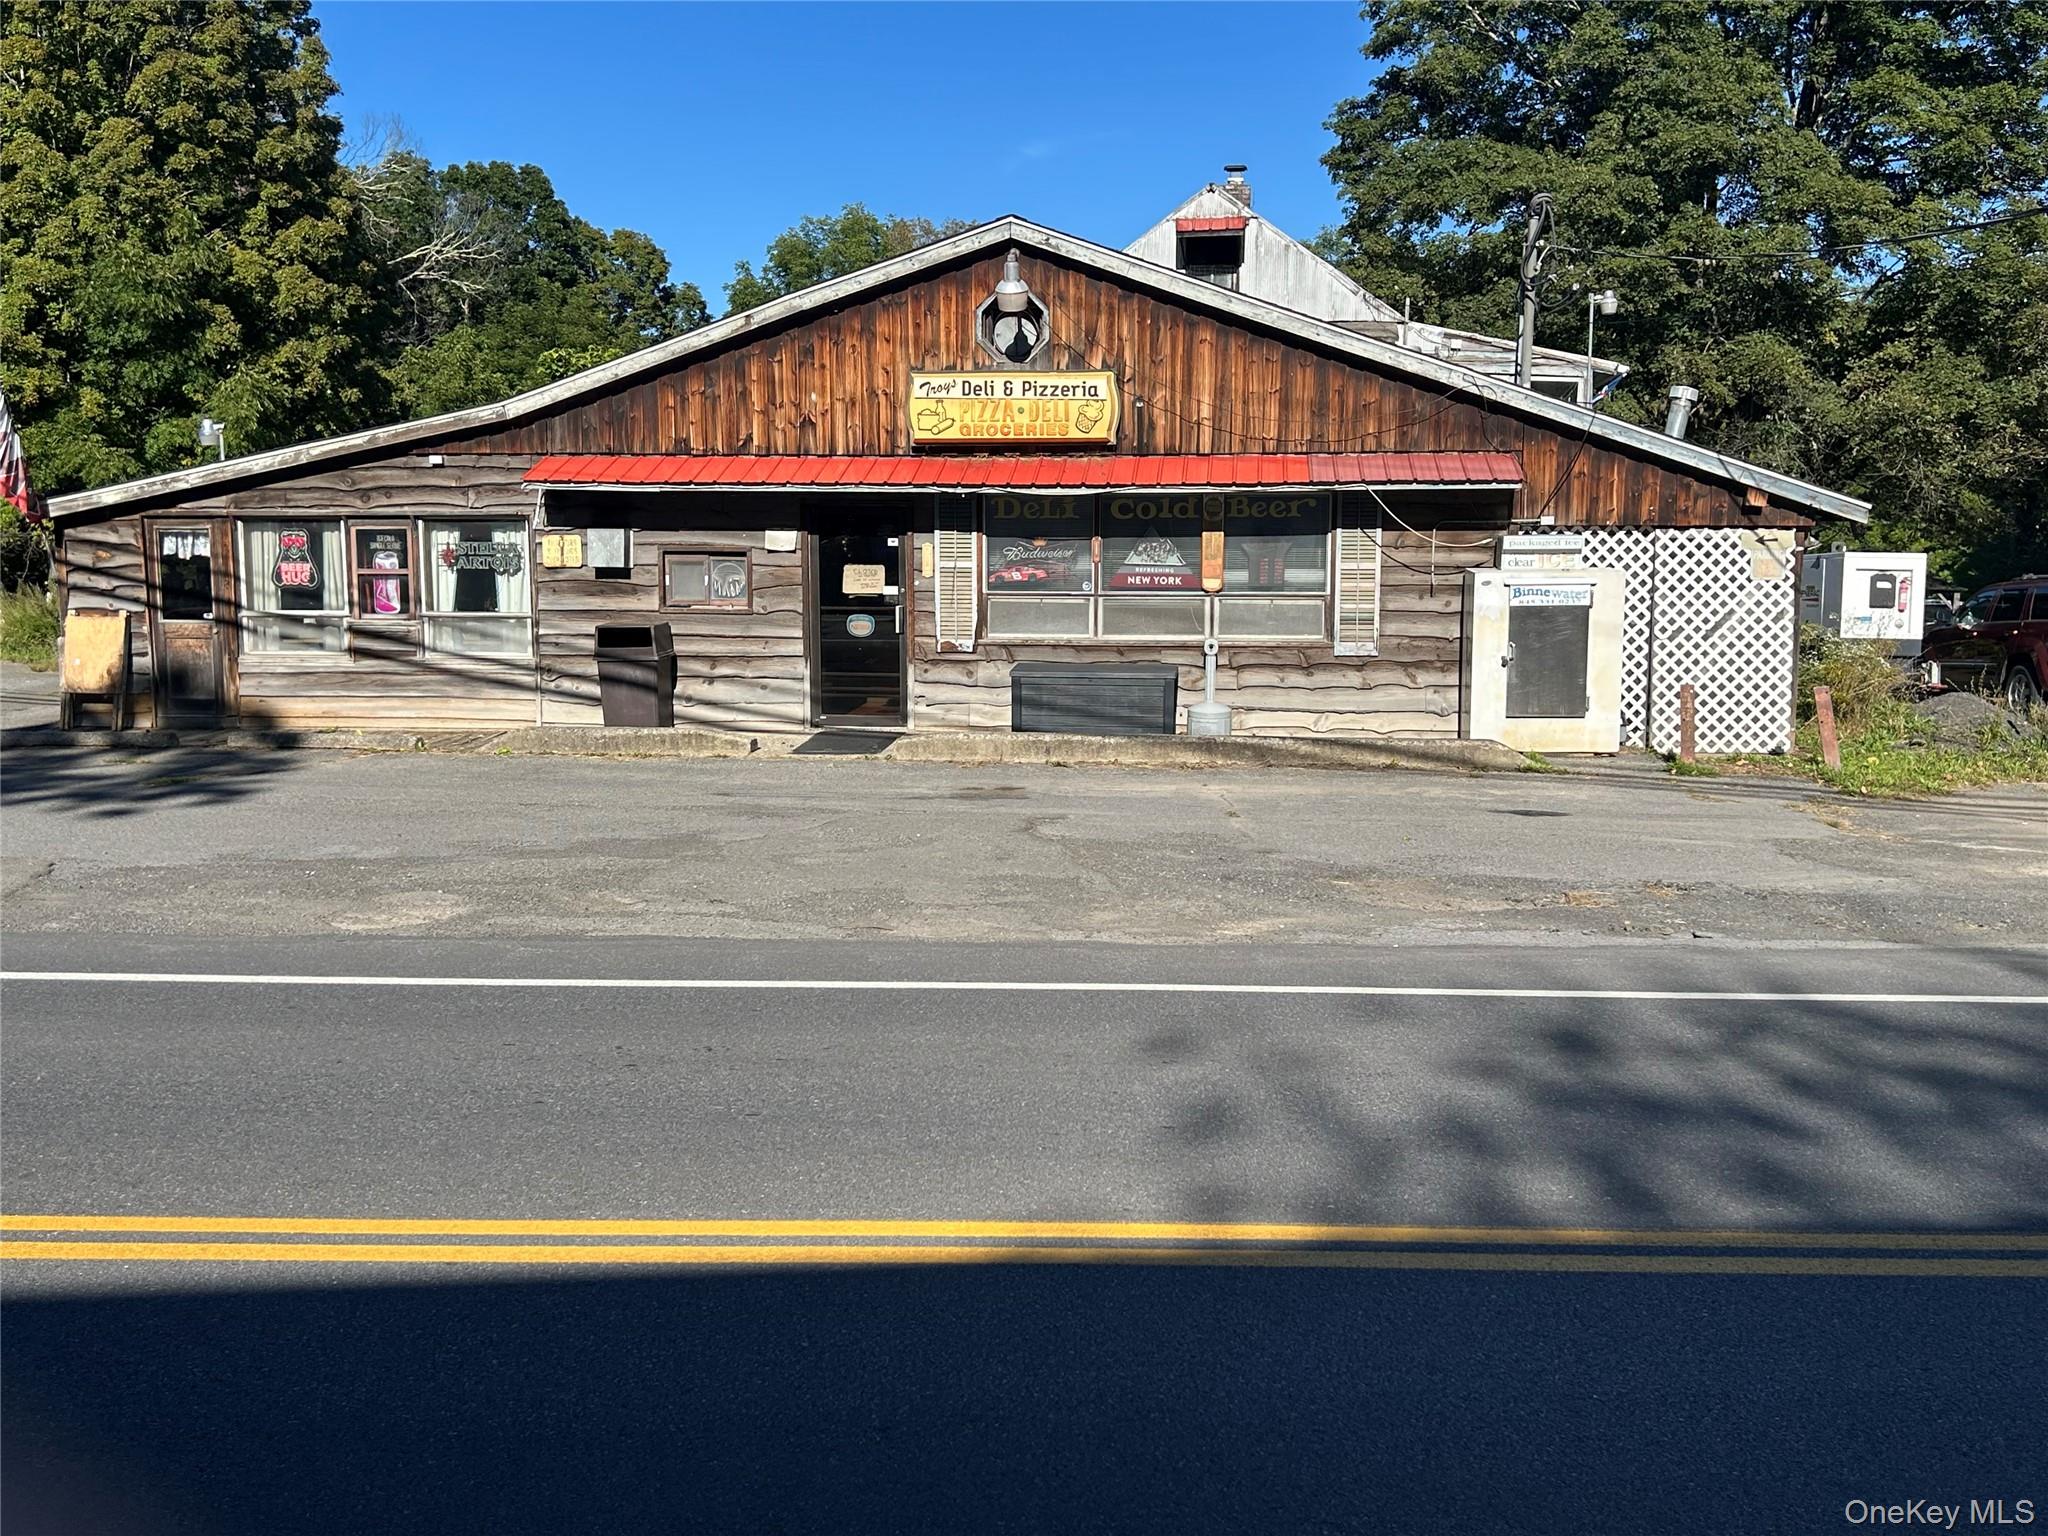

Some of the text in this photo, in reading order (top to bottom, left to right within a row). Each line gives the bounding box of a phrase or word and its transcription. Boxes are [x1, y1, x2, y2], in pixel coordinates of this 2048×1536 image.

[961, 380, 996, 397] Deli
[1003, 380, 1014, 397] &
[1022, 380, 1100, 398] Pizzeria
[959, 399, 1071, 423] PIZZA DELI
[959, 423, 1070, 437] GROCERIES
[1110, 497, 1200, 520] Cold
[1227, 496, 1317, 518] Beer
[457, 541, 519, 555] STELLA
[1003, 546, 1074, 561] Budweiser
[280, 562, 311, 572] BEER
[457, 556, 520, 572] ARTOIS
[1508, 556, 1536, 568] clear
[281, 571, 311, 585] HUG
[1127, 575, 1183, 586] NEW YORK
[1512, 586, 1589, 600] Binnewater
